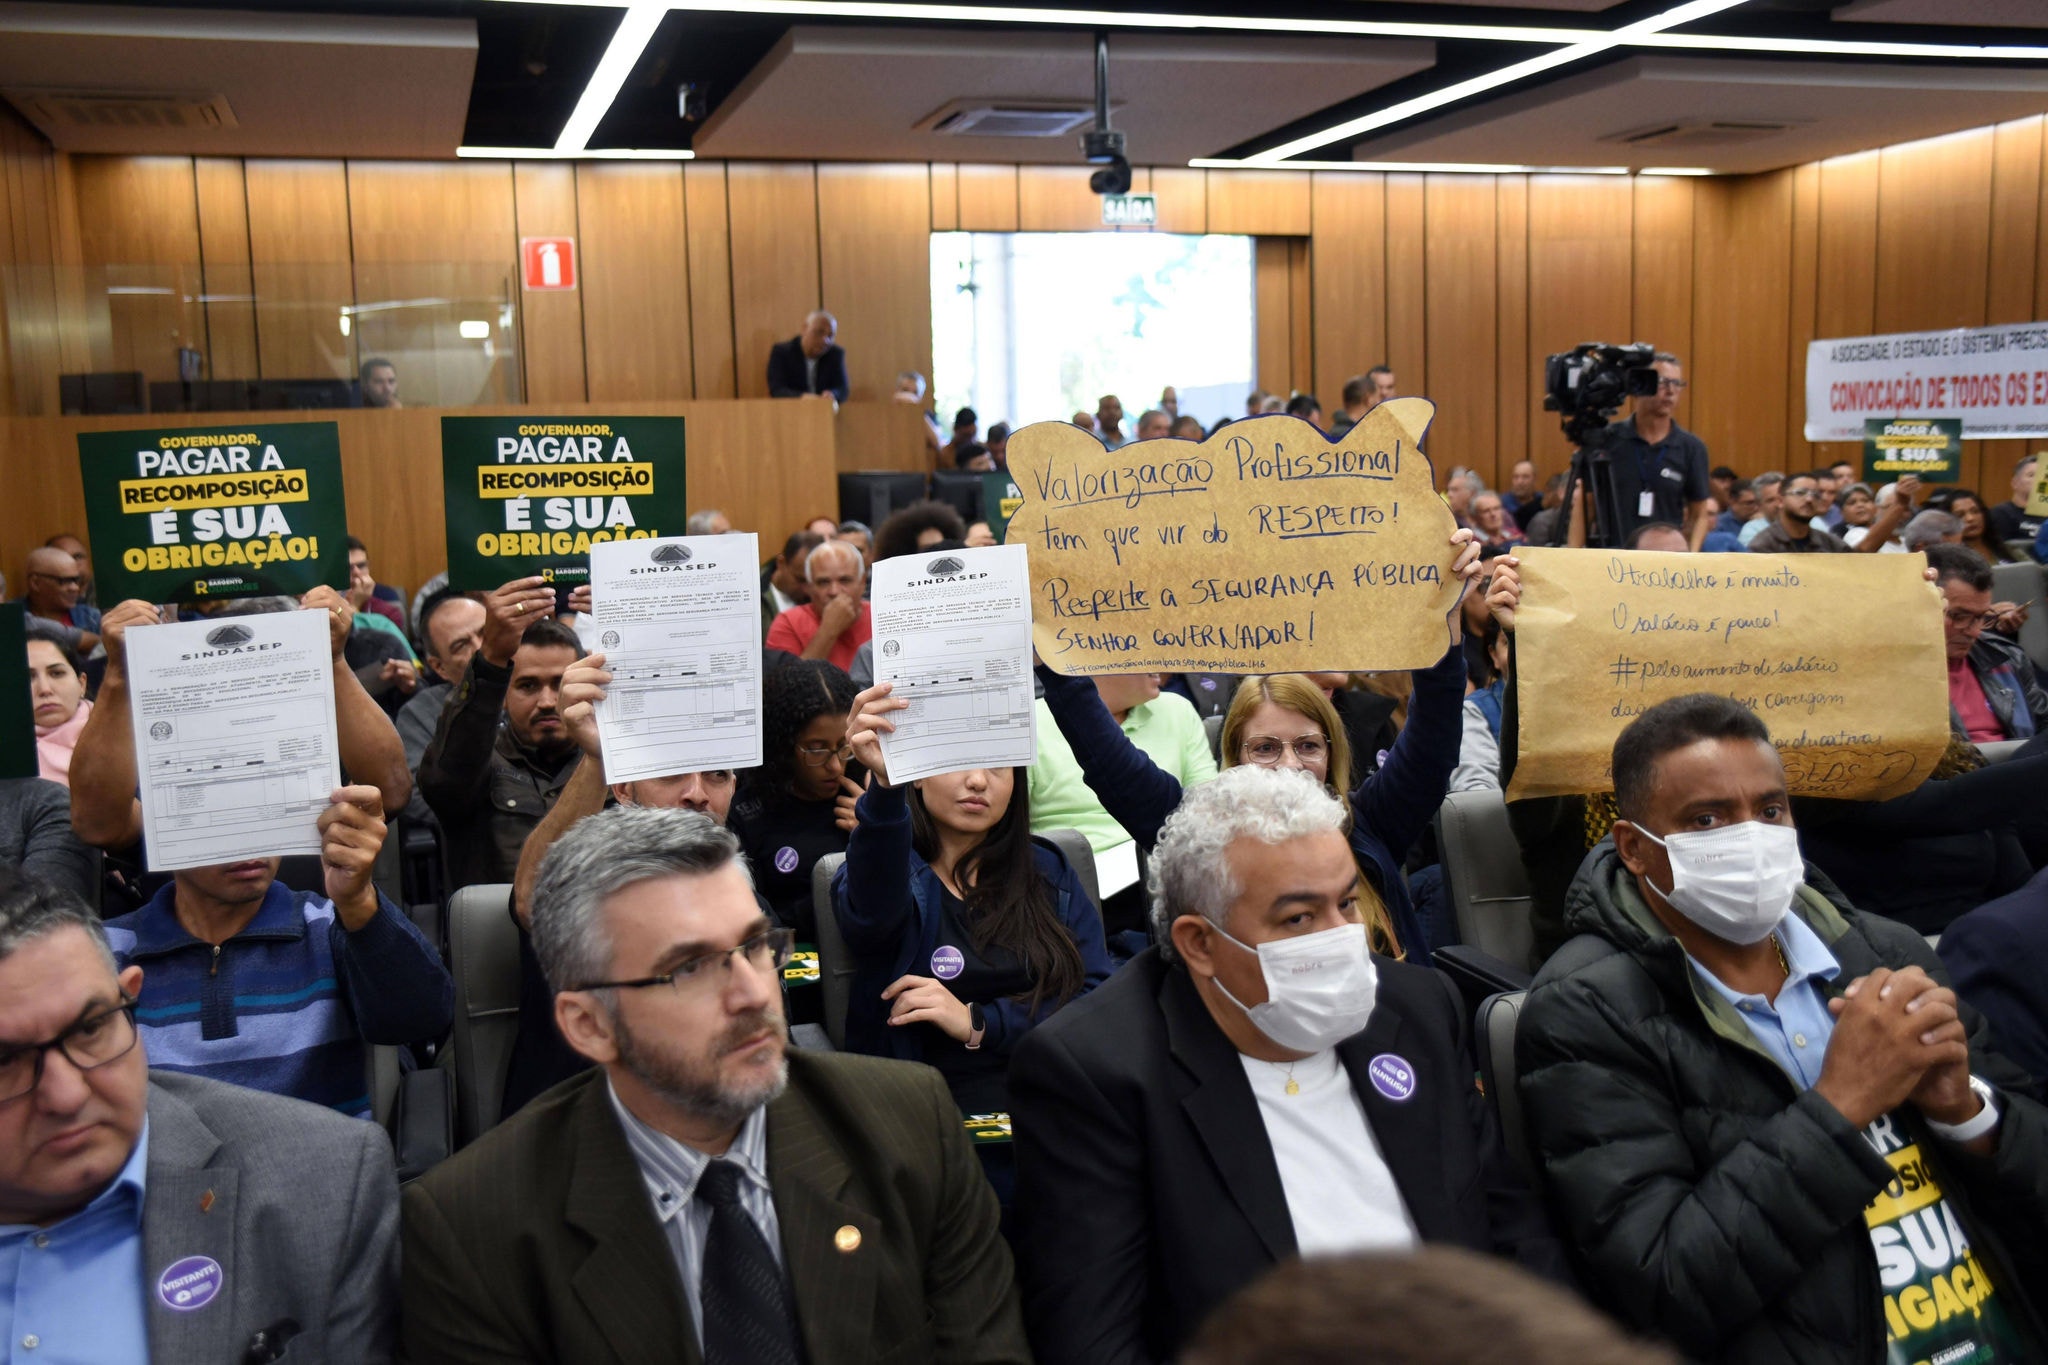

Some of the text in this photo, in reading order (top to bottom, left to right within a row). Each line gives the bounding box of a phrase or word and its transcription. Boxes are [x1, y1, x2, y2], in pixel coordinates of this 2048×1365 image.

[1104, 197, 1153, 221] SAÍDA
[1830, 371, 1922, 417] CONVOCAÇÃO
[1927, 376, 1946, 408] DE
[1951, 373, 2001, 408] TODOS
[2006, 371, 2028, 407] OS
[159, 433, 262, 449] GOVERNADOR,
[518, 424, 614, 437] GOVERNADOR,
[1884, 424, 1940, 436] PAGAR A
[138, 444, 285, 477] PAGAR A
[497, 436, 634, 463] PAGAR A
[1900, 447, 1939, 461] SUA
[481, 466, 650, 490] RECOMPOSIÇÃO
[1034, 437, 1400, 509] Valorização Profissional
[124, 474, 304, 504] RECOMPOSIÇÃO
[150, 504, 292, 545] É SUA
[505, 494, 636, 530] É SUA
[1037, 514, 1088, 550] tem
[1104, 524, 1139, 566] que
[1158, 525, 1187, 546] vir
[1249, 502, 1398, 535] RESPEITO!
[123, 533, 319, 573] OBRIGAÇÃO!
[629, 562, 718, 575] SINDASEP
[907, 572, 989, 588] SINDASEP
[1043, 577, 1149, 621] Respeite
[1160, 587, 1178, 607] a
[1188, 569, 1334, 605] SEGURANÇA
[1056, 611, 1314, 654] SENHOR GOVERNADOR!
[1612, 602, 1781, 644] O salário é pouco!
[181, 642, 283, 661] SINDASEP
[1372, 1065, 1408, 1096] VISITANTE
[1869, 1199, 1970, 1287] SUA
[162, 1263, 216, 1292] VISITANTE
